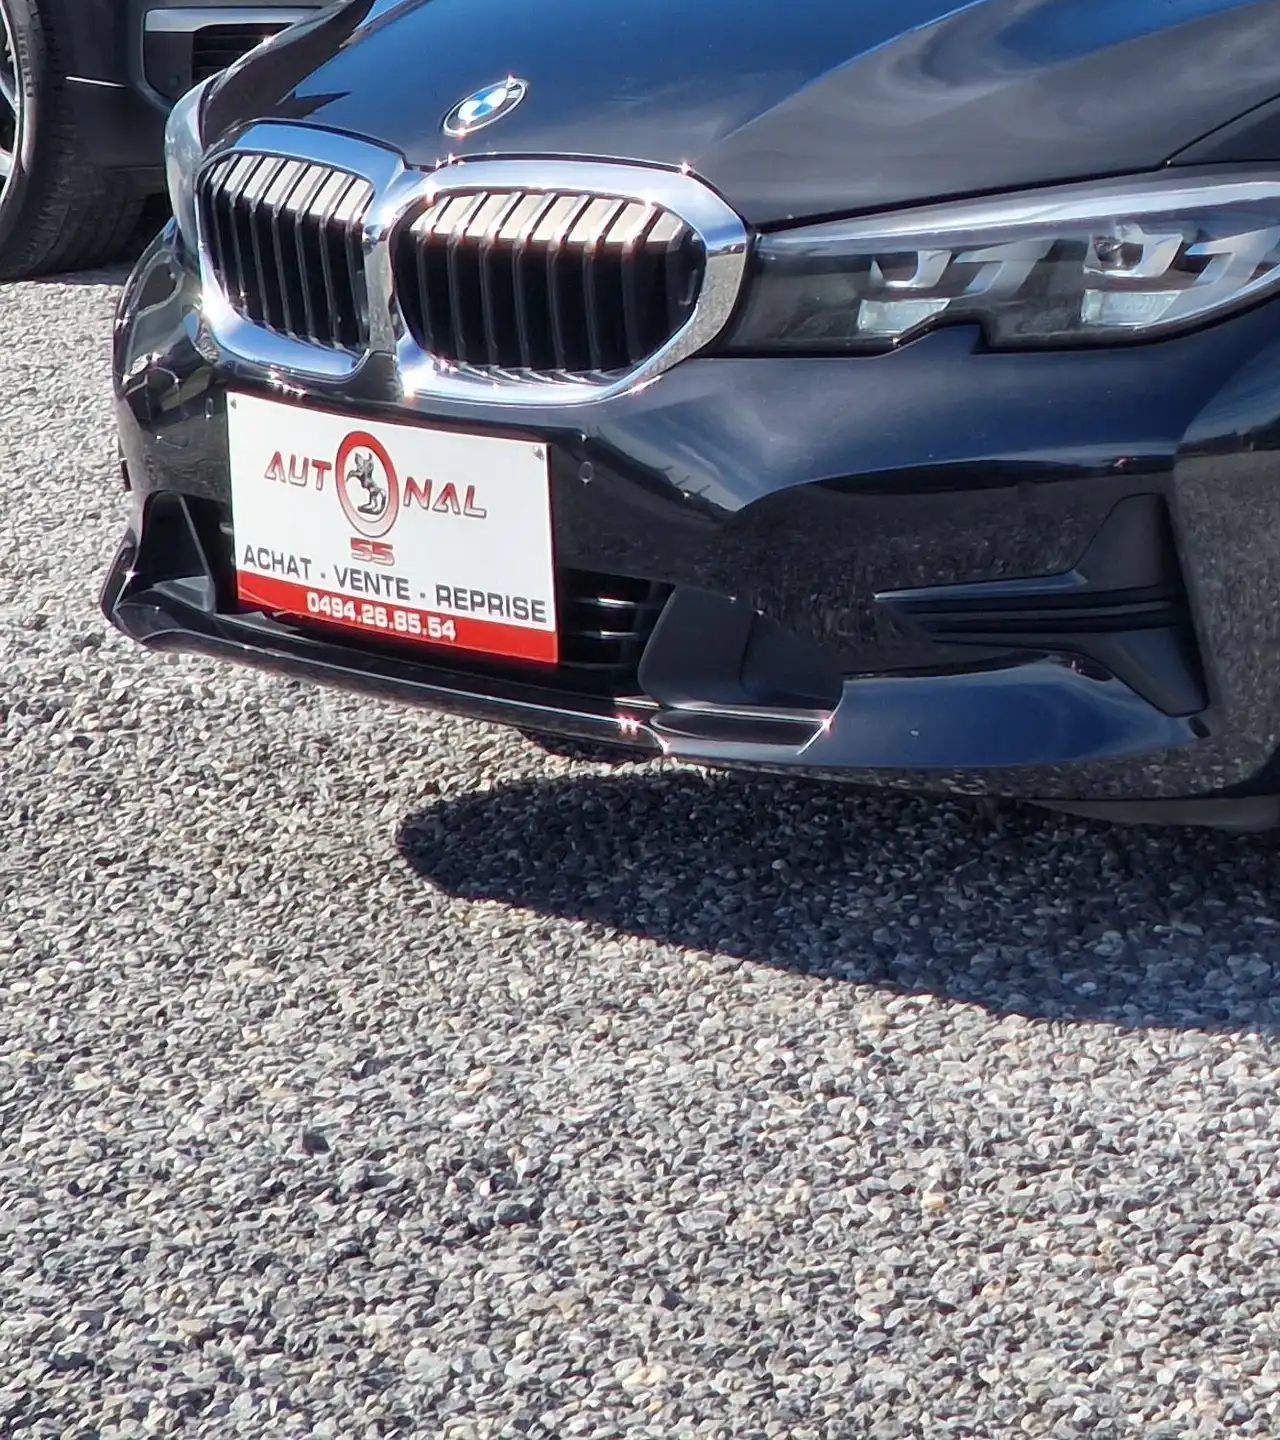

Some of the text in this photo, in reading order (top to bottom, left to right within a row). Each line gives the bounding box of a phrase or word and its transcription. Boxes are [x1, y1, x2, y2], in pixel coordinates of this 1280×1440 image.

[350, 538, 395, 566] 55
[243, 544, 312, 580] ACHAT
[334, 564, 410, 601] VENTE
[435, 584, 547, 623] REPRISE
[306, 591, 457, 641] 0494.26.85.54
